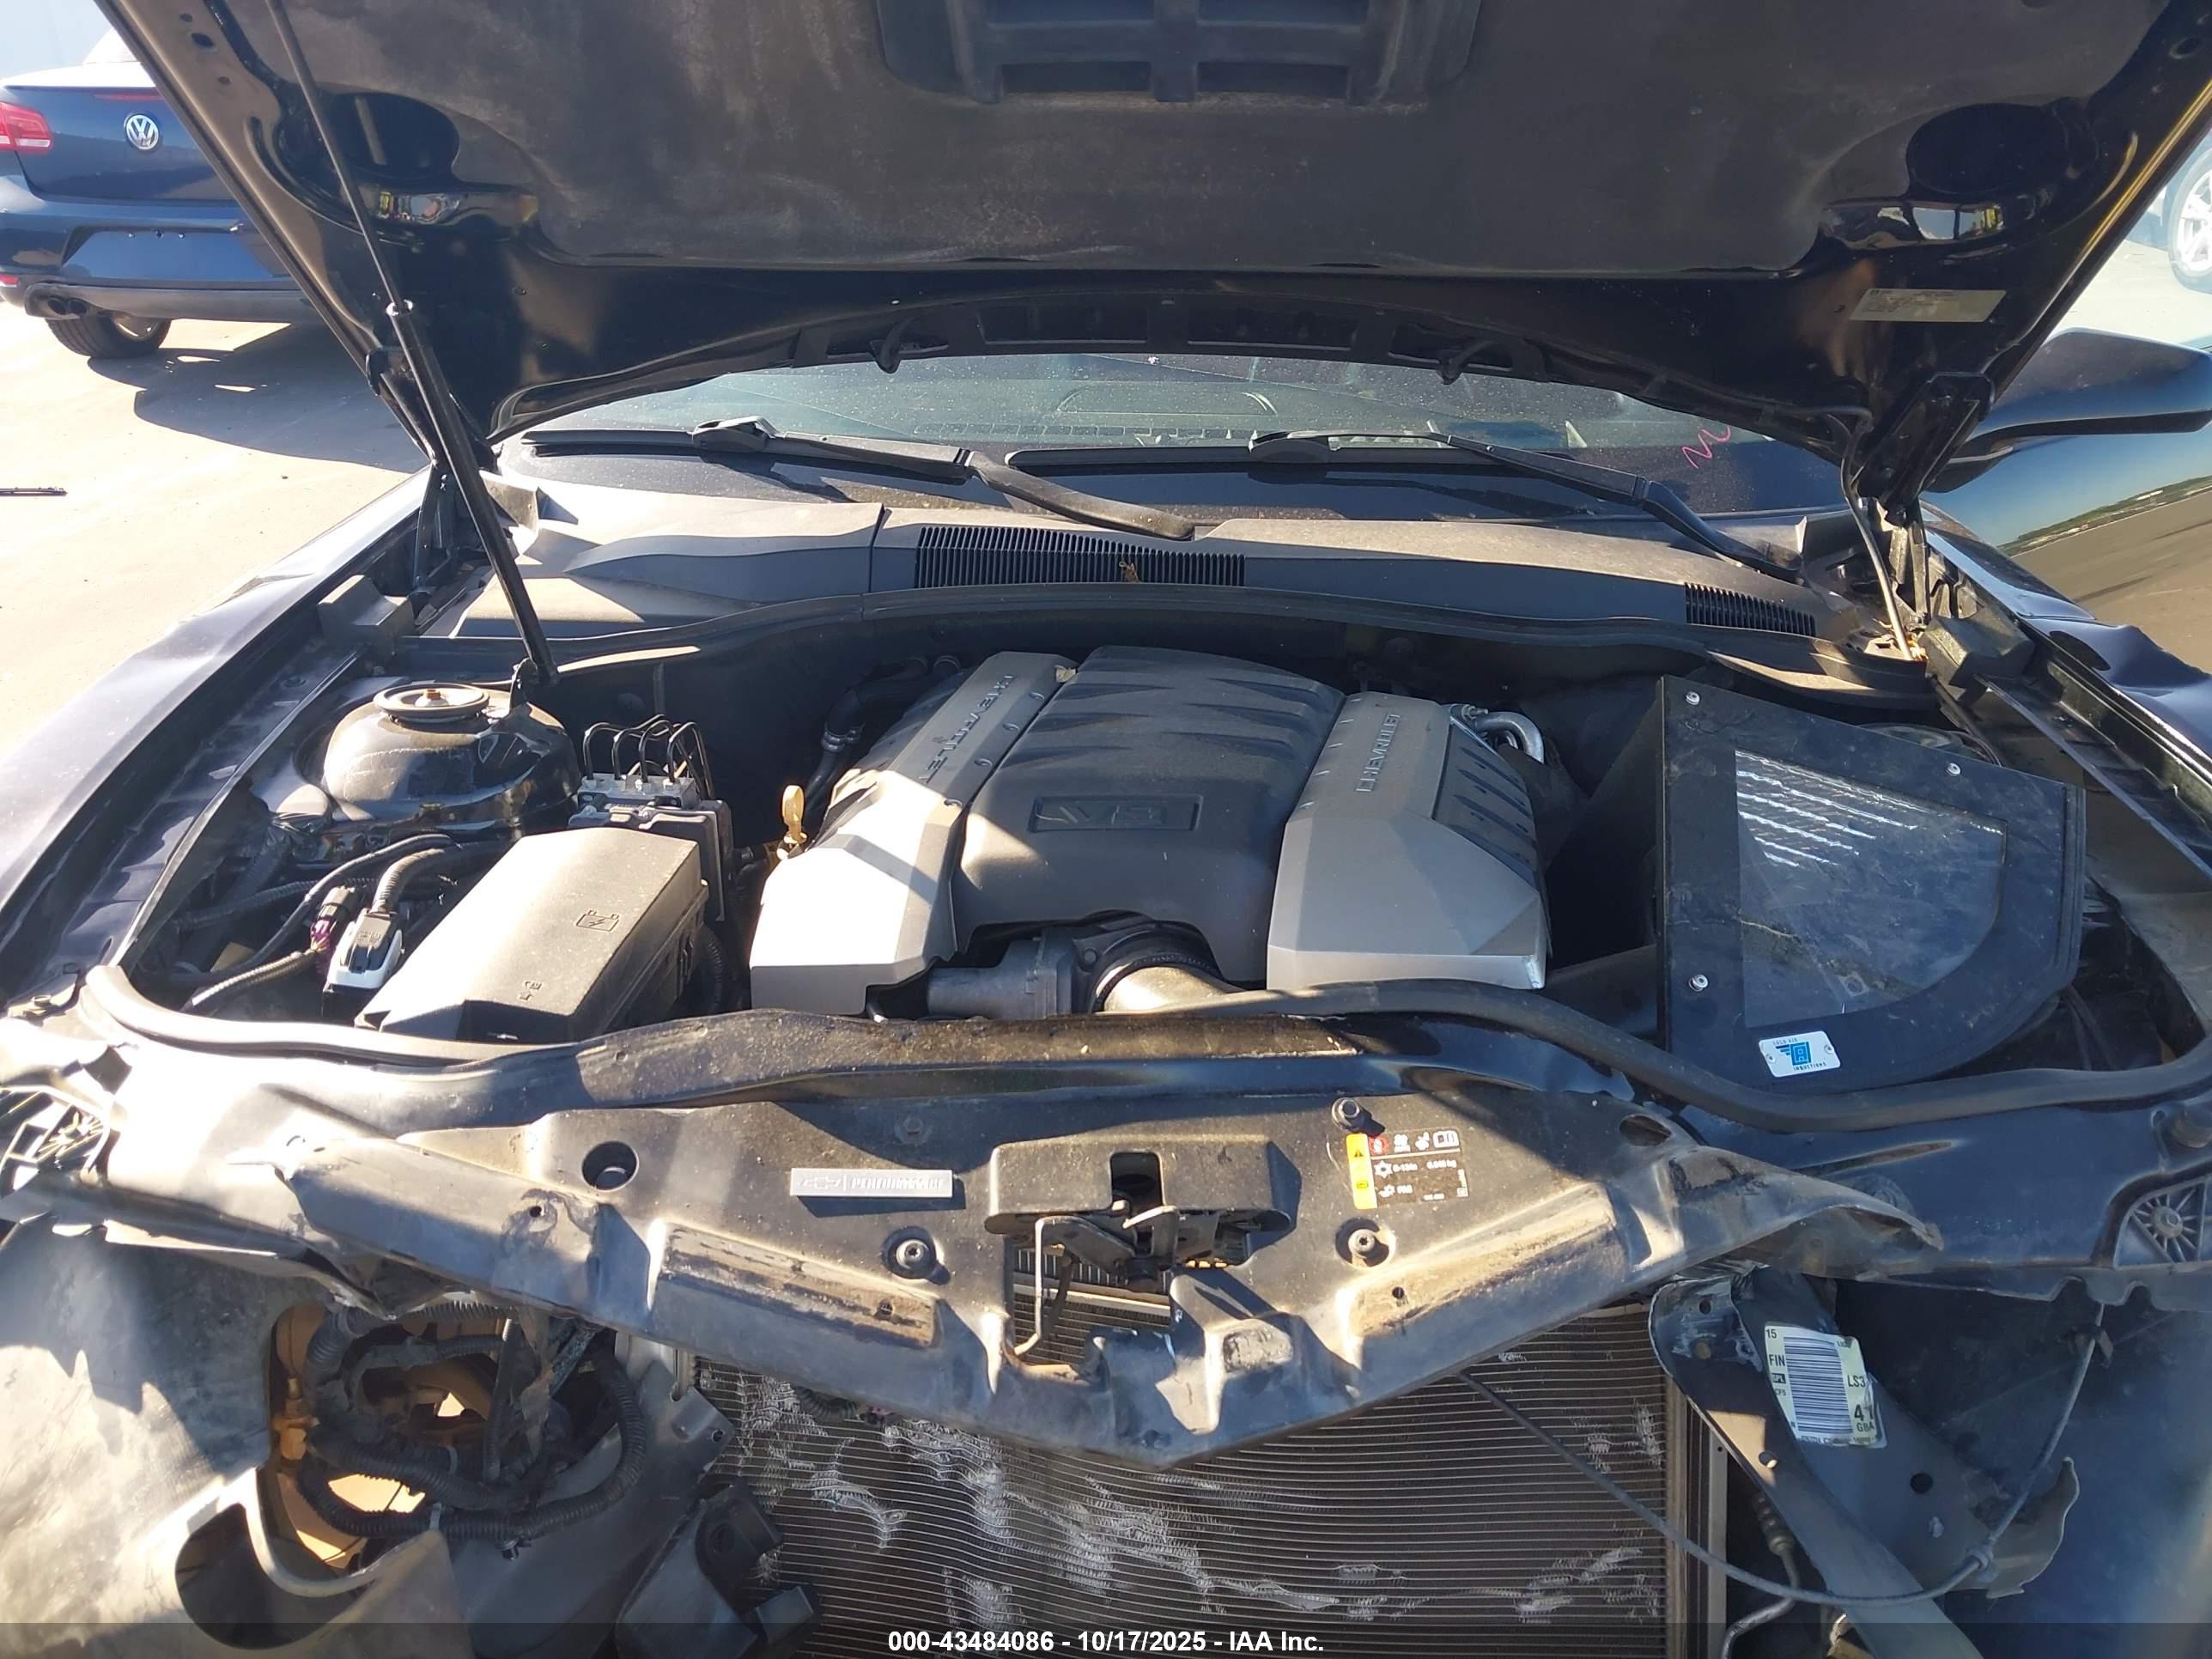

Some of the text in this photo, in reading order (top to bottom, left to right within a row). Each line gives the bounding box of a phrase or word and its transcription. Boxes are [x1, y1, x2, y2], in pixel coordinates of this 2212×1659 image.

[1766, 1328, 1778, 1339] 15
[1769, 1353, 1786, 1367] FIN
[1847, 1374, 1866, 1388] LS3
